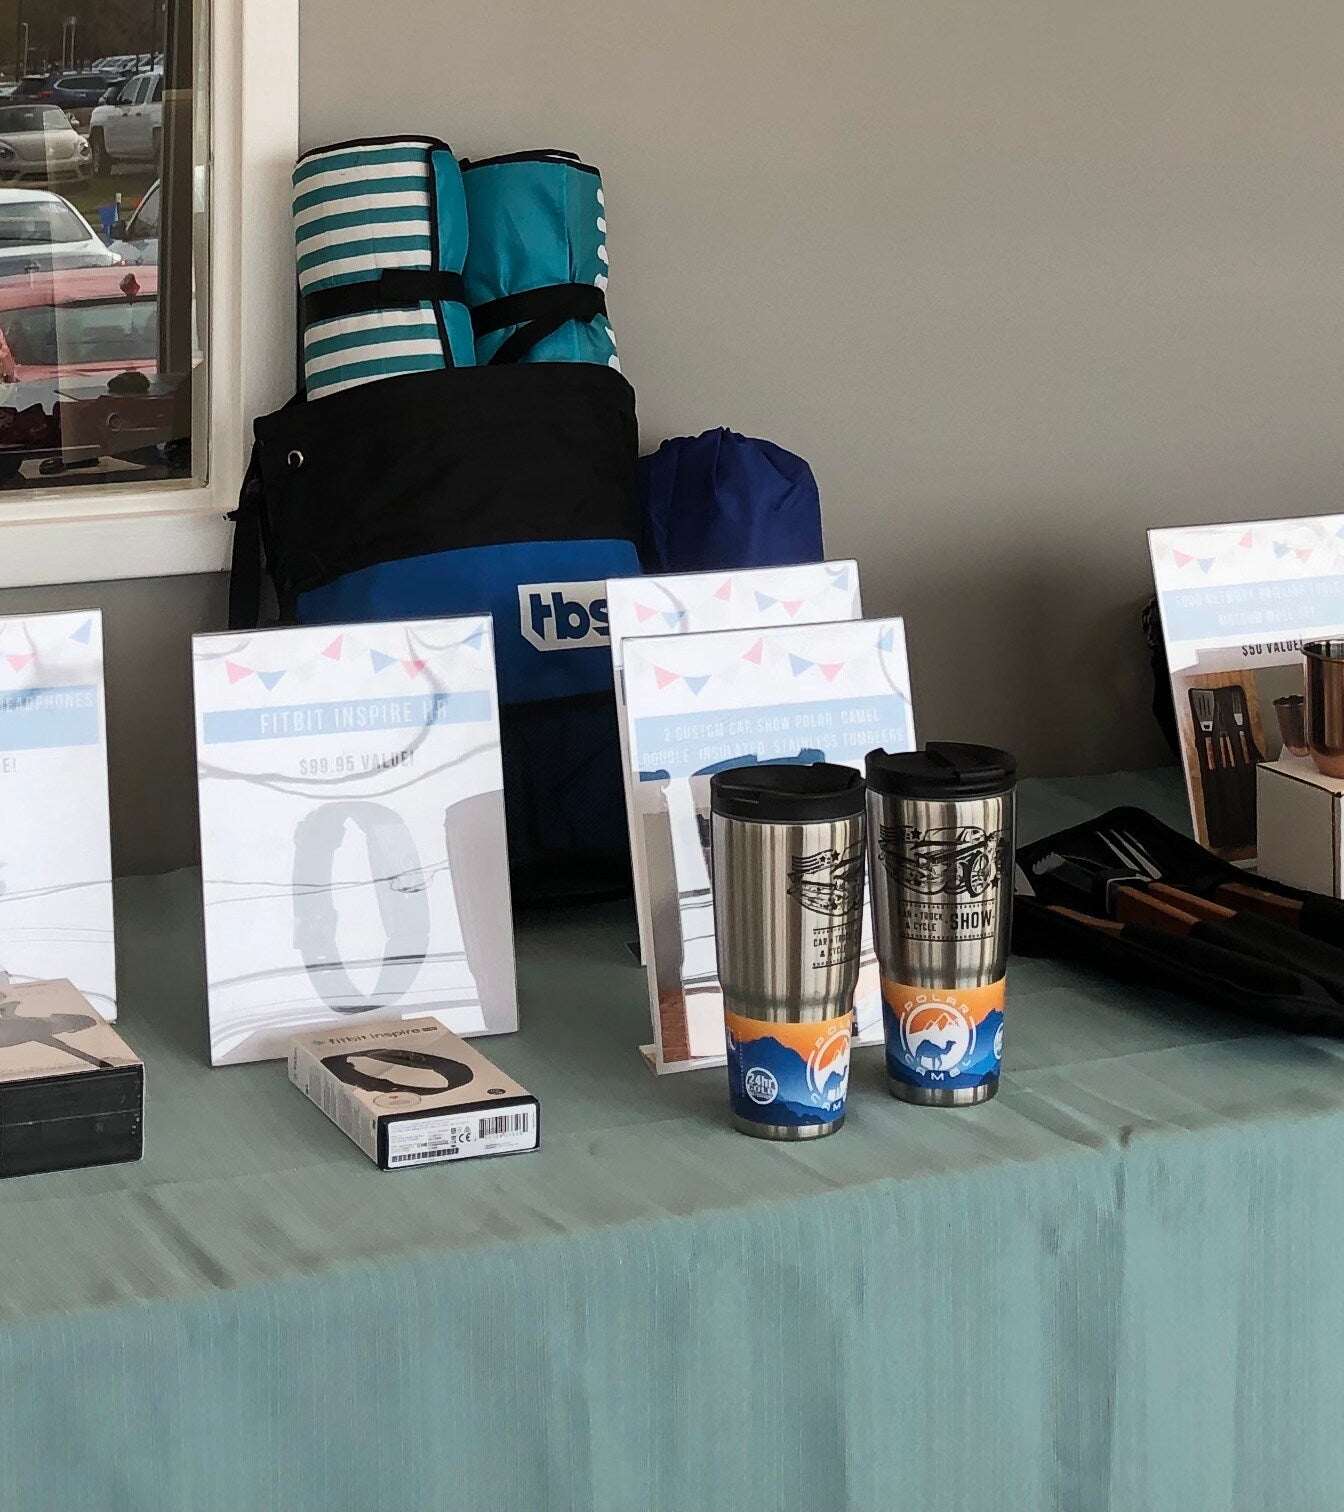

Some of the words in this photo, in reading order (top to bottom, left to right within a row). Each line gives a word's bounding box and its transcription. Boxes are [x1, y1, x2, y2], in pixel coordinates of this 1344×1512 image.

[1266, 638, 1305, 655] VALUE!
[260, 708, 324, 735] FITBIT
[334, 700, 413, 728] INSPIRE
[675, 721, 724, 742] CUSTOM
[729, 719, 754, 735] CAR
[756, 714, 791, 734] SHOW
[795, 711, 833, 729] POLAR
[840, 707, 880, 725] CAMEL
[299, 751, 355, 776] $99.95
[361, 749, 415, 772] VALUE!
[913, 922, 937, 932] CYCLE
[920, 911, 943, 922] TRUCK
[949, 909, 992, 931] SHOW
[813, 937, 828, 948] CAR
[904, 993, 970, 1015] POLAR
[904, 1053, 972, 1081] CAMEL
[747, 1072, 775, 1088] 24hr
